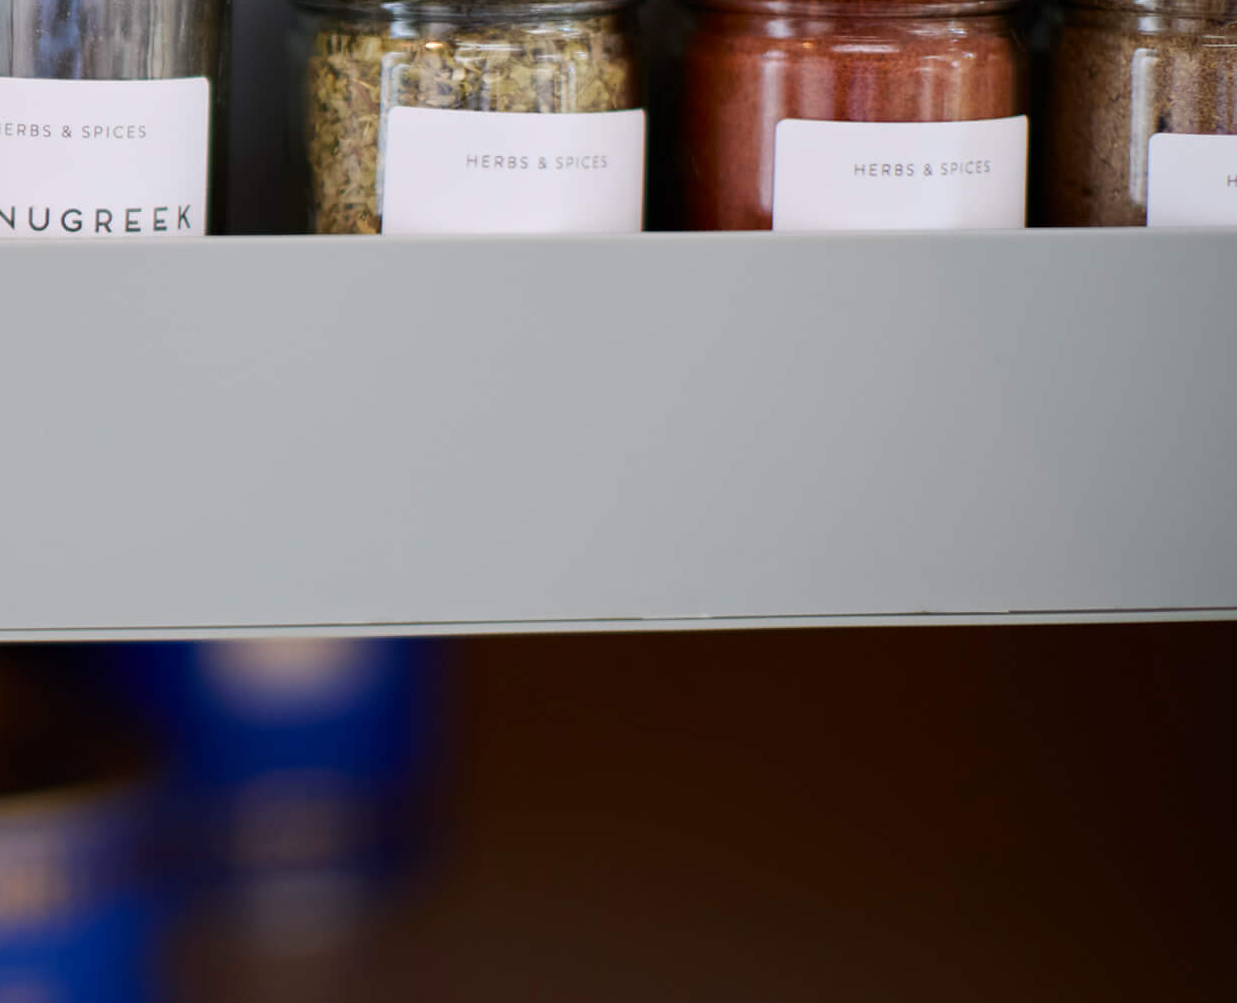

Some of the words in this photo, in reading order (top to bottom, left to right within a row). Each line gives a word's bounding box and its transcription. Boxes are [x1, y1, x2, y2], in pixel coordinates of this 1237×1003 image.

[61, 125, 72, 139] &
[81, 125, 147, 139] SPICES
[466, 155, 530, 169] HERBS
[538, 156, 548, 170] &
[555, 155, 608, 170] SPICES
[854, 162, 916, 177] HERBS
[923, 162, 934, 177] &
[940, 159, 991, 176] SPICES
